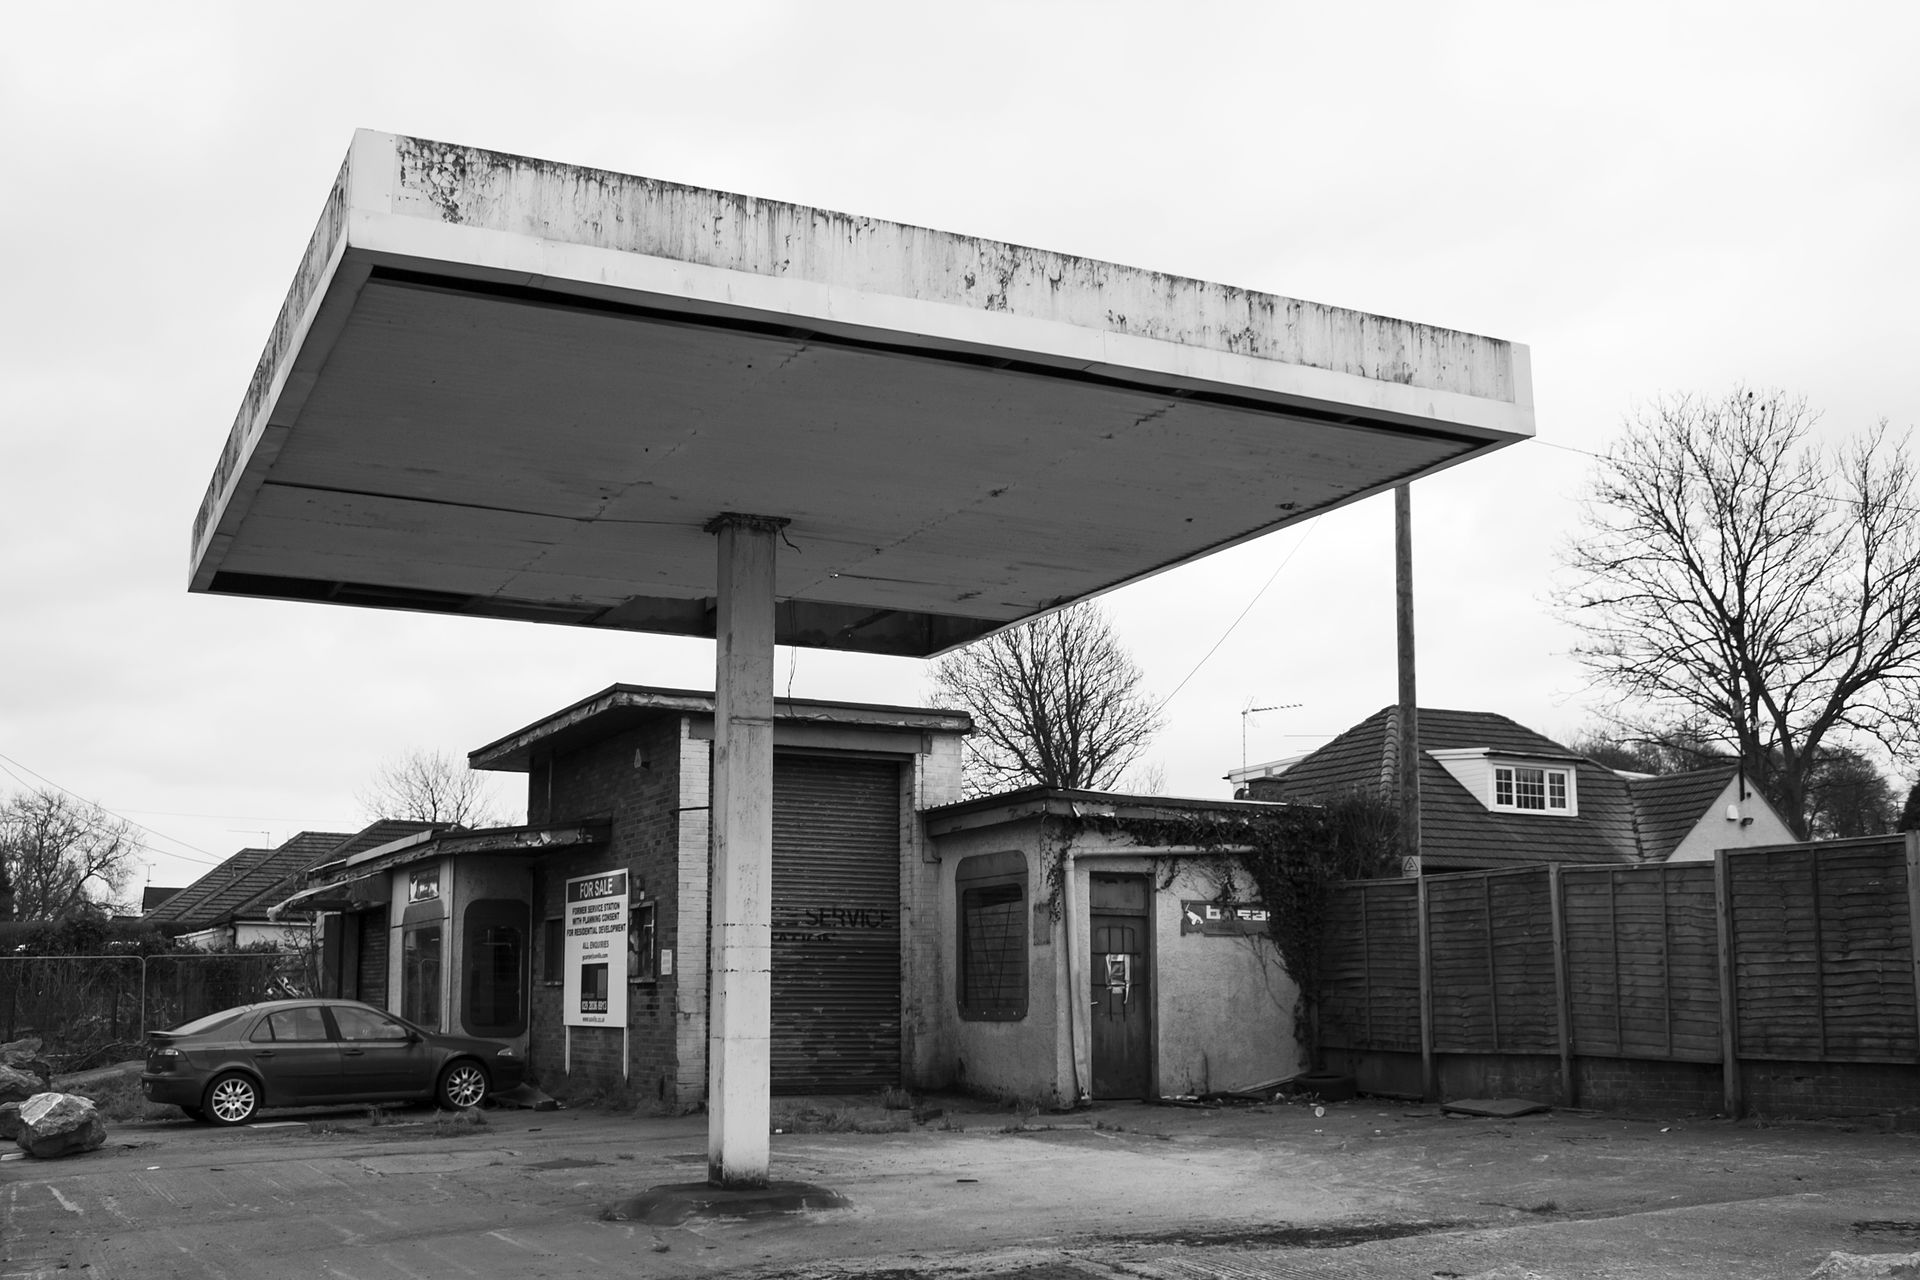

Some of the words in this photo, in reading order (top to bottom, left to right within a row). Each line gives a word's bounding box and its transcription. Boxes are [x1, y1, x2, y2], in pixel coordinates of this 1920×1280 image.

[579, 882, 593, 899] FOR
[594, 878, 613, 896] SALE
[572, 906, 587, 915] FORMER
[588, 904, 603, 913] SERVICE
[604, 902, 620, 911] STATION
[572, 917, 582, 925] WITH
[583, 915, 601, 924] PLANNING
[602, 912, 620, 922] CONSENT
[805, 908, 893, 928] SERVICE
[566, 928, 574, 936] FOR
[574, 926, 598, 936] RESIDENTIAL
[598, 923, 626, 934] DEVELOPMENT
[589, 940, 609, 949] ENQUIRIES
